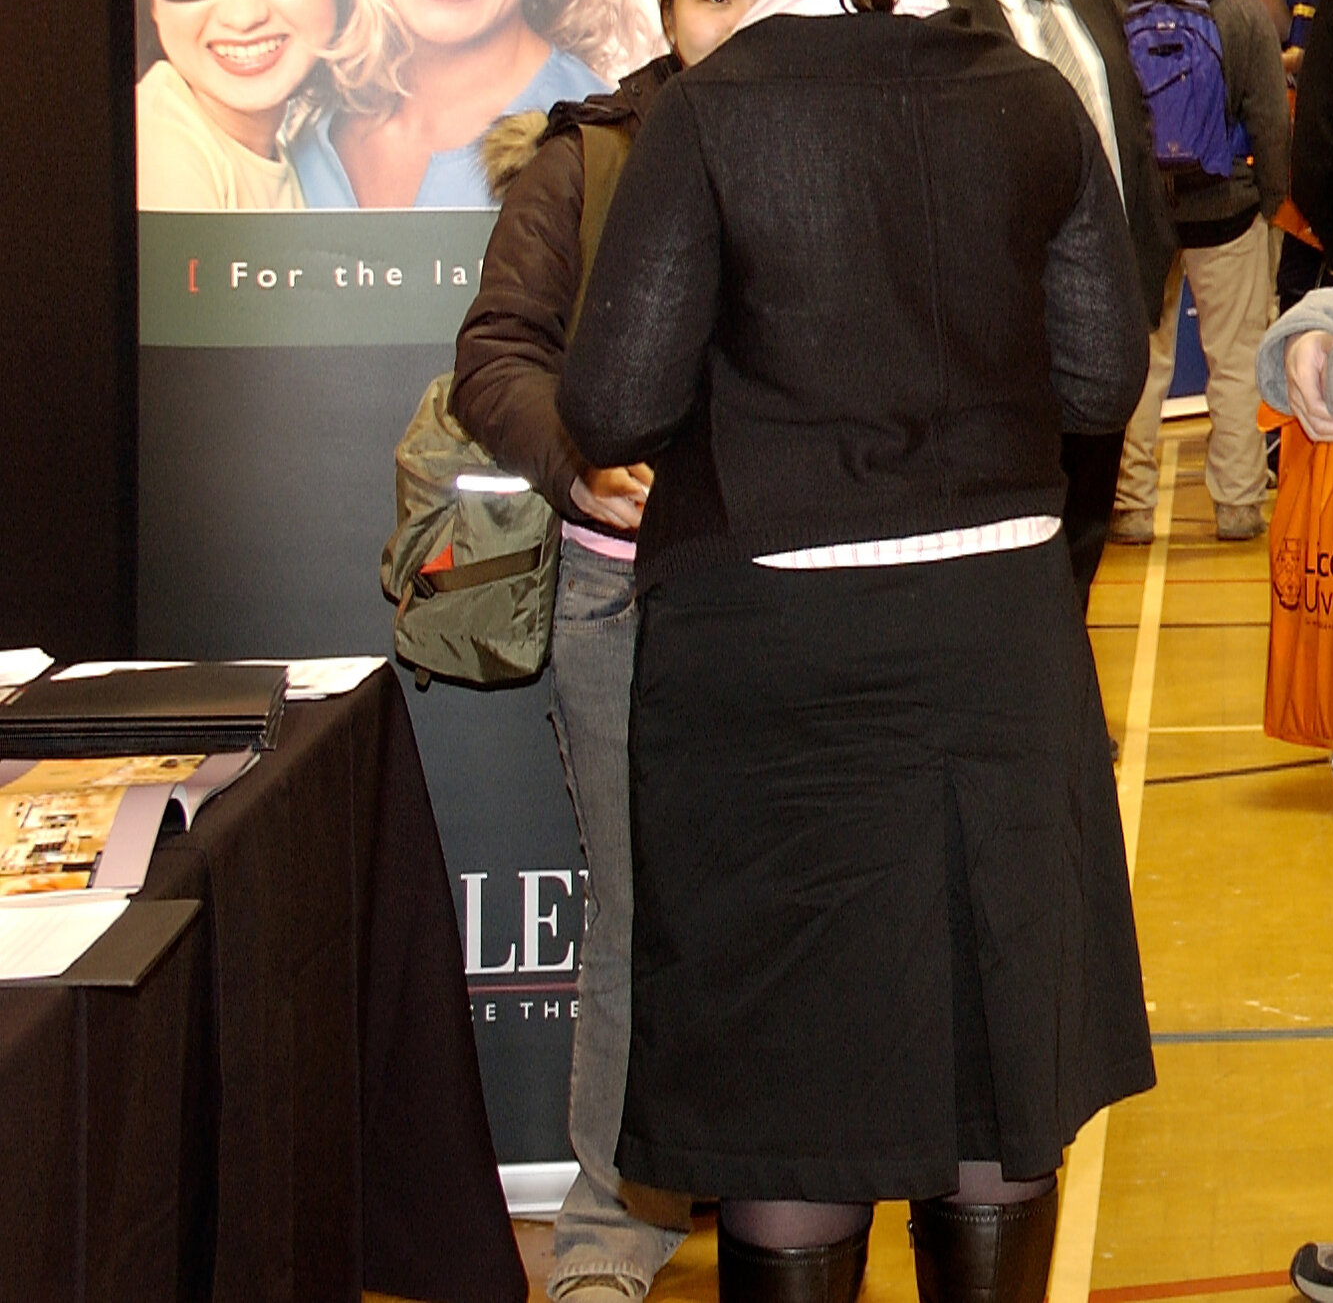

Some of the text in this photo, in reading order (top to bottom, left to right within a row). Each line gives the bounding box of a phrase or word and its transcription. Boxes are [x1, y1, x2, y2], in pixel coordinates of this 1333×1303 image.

[231, 261, 304, 289] For
[334, 260, 404, 287] the
[434, 259, 484, 286] la
[460, 868, 590, 975] LE
[469, 1001, 497, 1022] E
